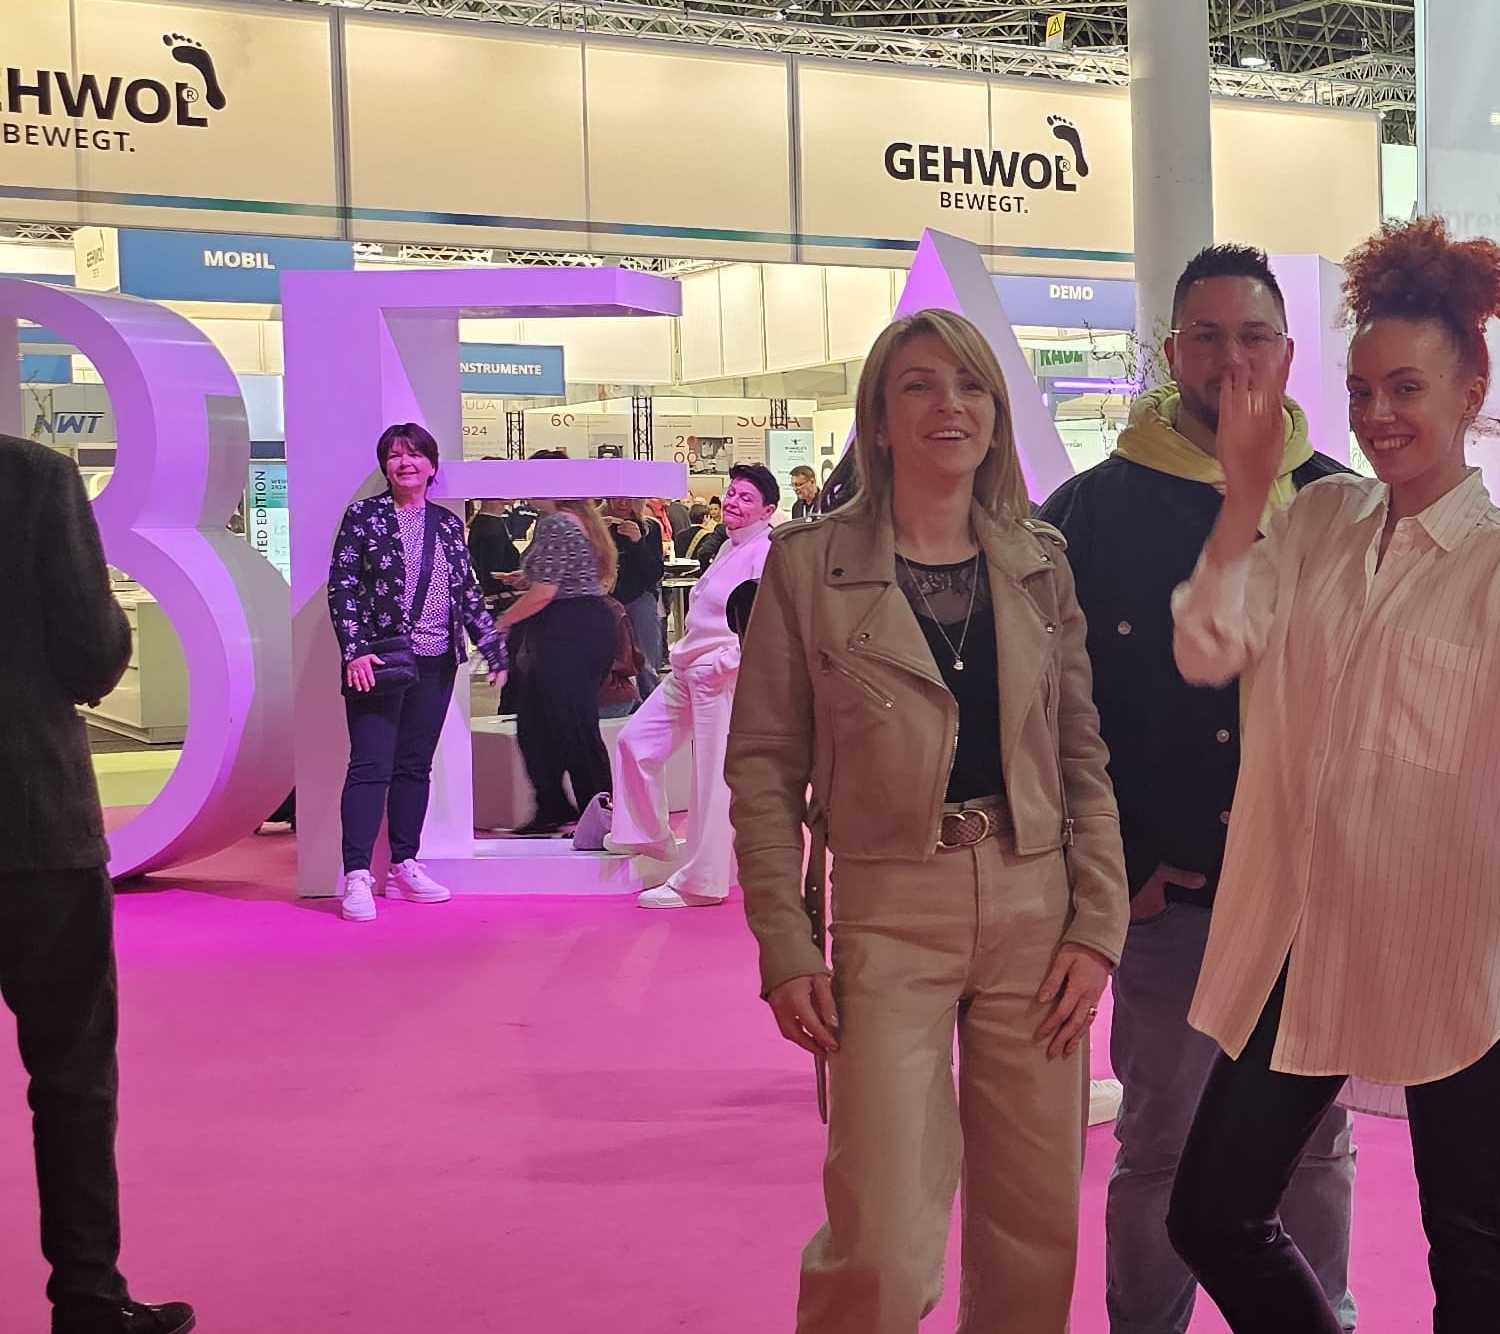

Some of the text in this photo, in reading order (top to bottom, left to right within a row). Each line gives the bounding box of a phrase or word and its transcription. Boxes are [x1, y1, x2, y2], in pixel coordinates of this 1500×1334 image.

[0, 68, 209, 128] HWOL
[3, 122, 136, 153] BEWEGT.
[884, 142, 1077, 192] GEHWOL
[940, 191, 1028, 214] BEWEGT.
[203, 250, 276, 270] MOBIL
[1049, 284, 1094, 300] DEMO
[459, 362, 542, 375] NSTRUMENTE
[463, 400, 497, 410] UDA
[462, 426, 488, 436] 924
[254, 471, 268, 559] TED EDITION
